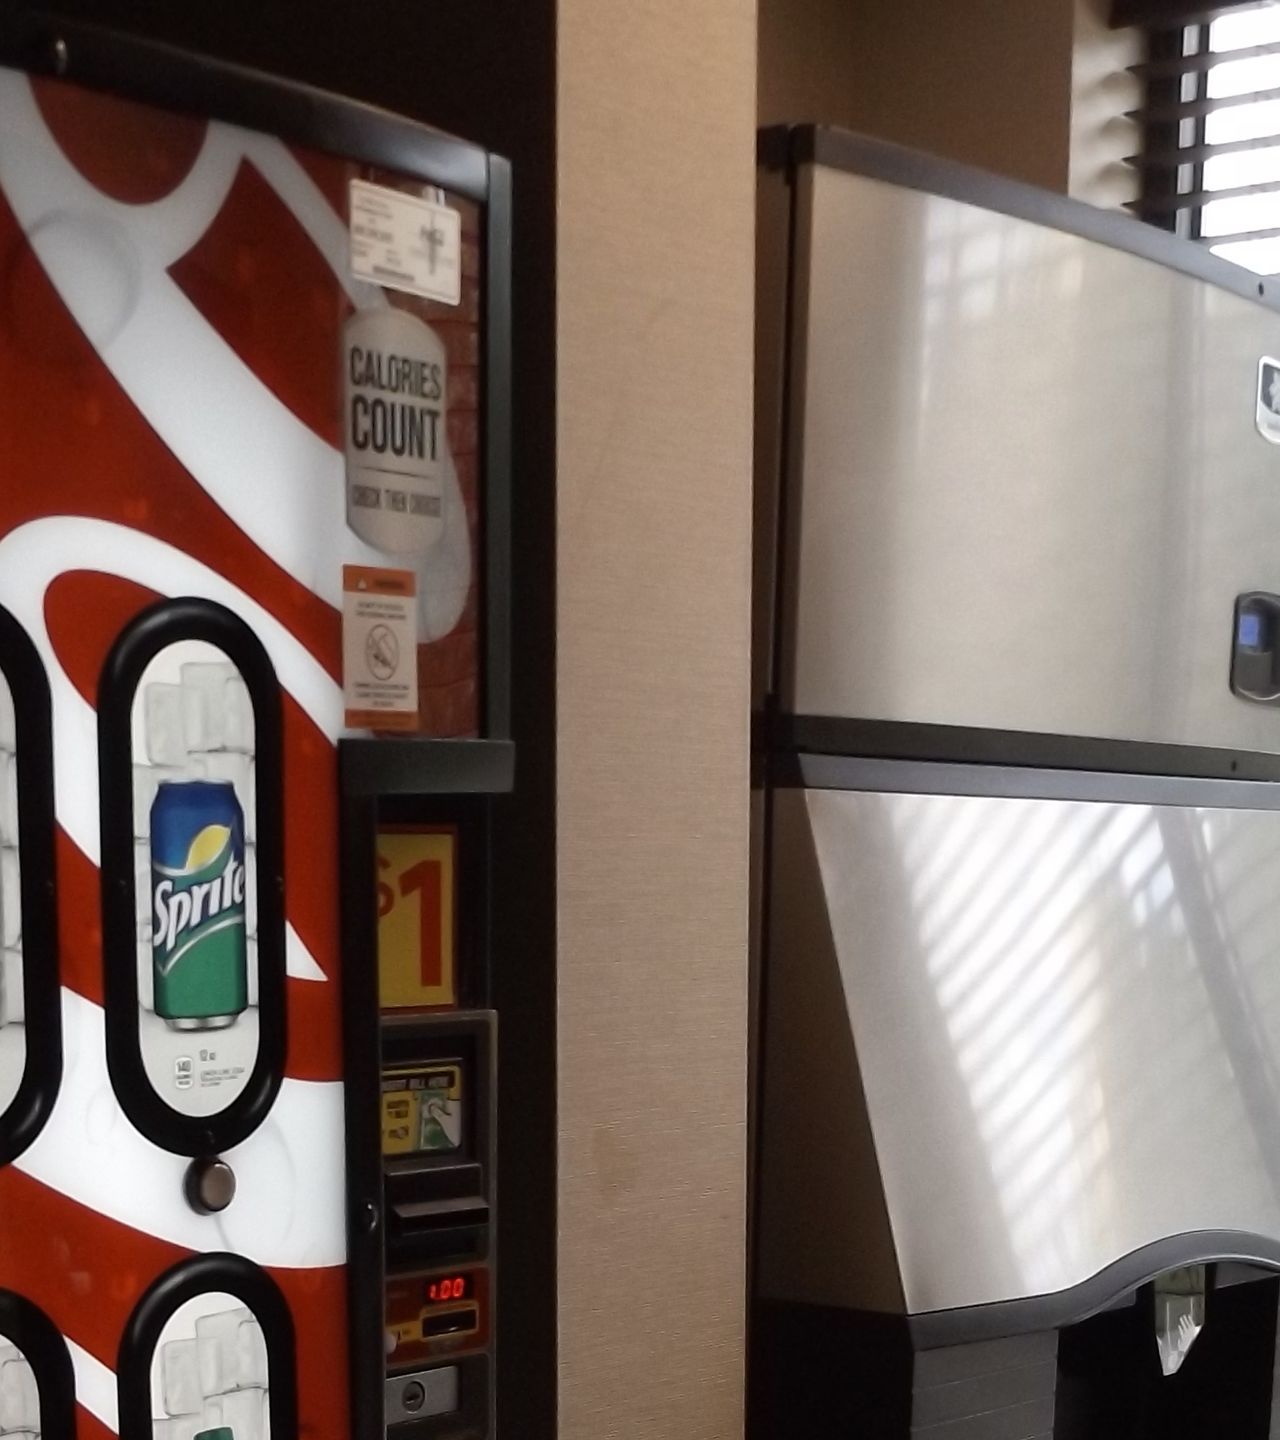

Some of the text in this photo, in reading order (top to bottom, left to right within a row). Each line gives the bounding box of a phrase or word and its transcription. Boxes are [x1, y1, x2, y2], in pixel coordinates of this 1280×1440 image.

[350, 346, 442, 401] CALORIES
[351, 394, 440, 461] COUNT
[153, 850, 245, 952] Sprite
